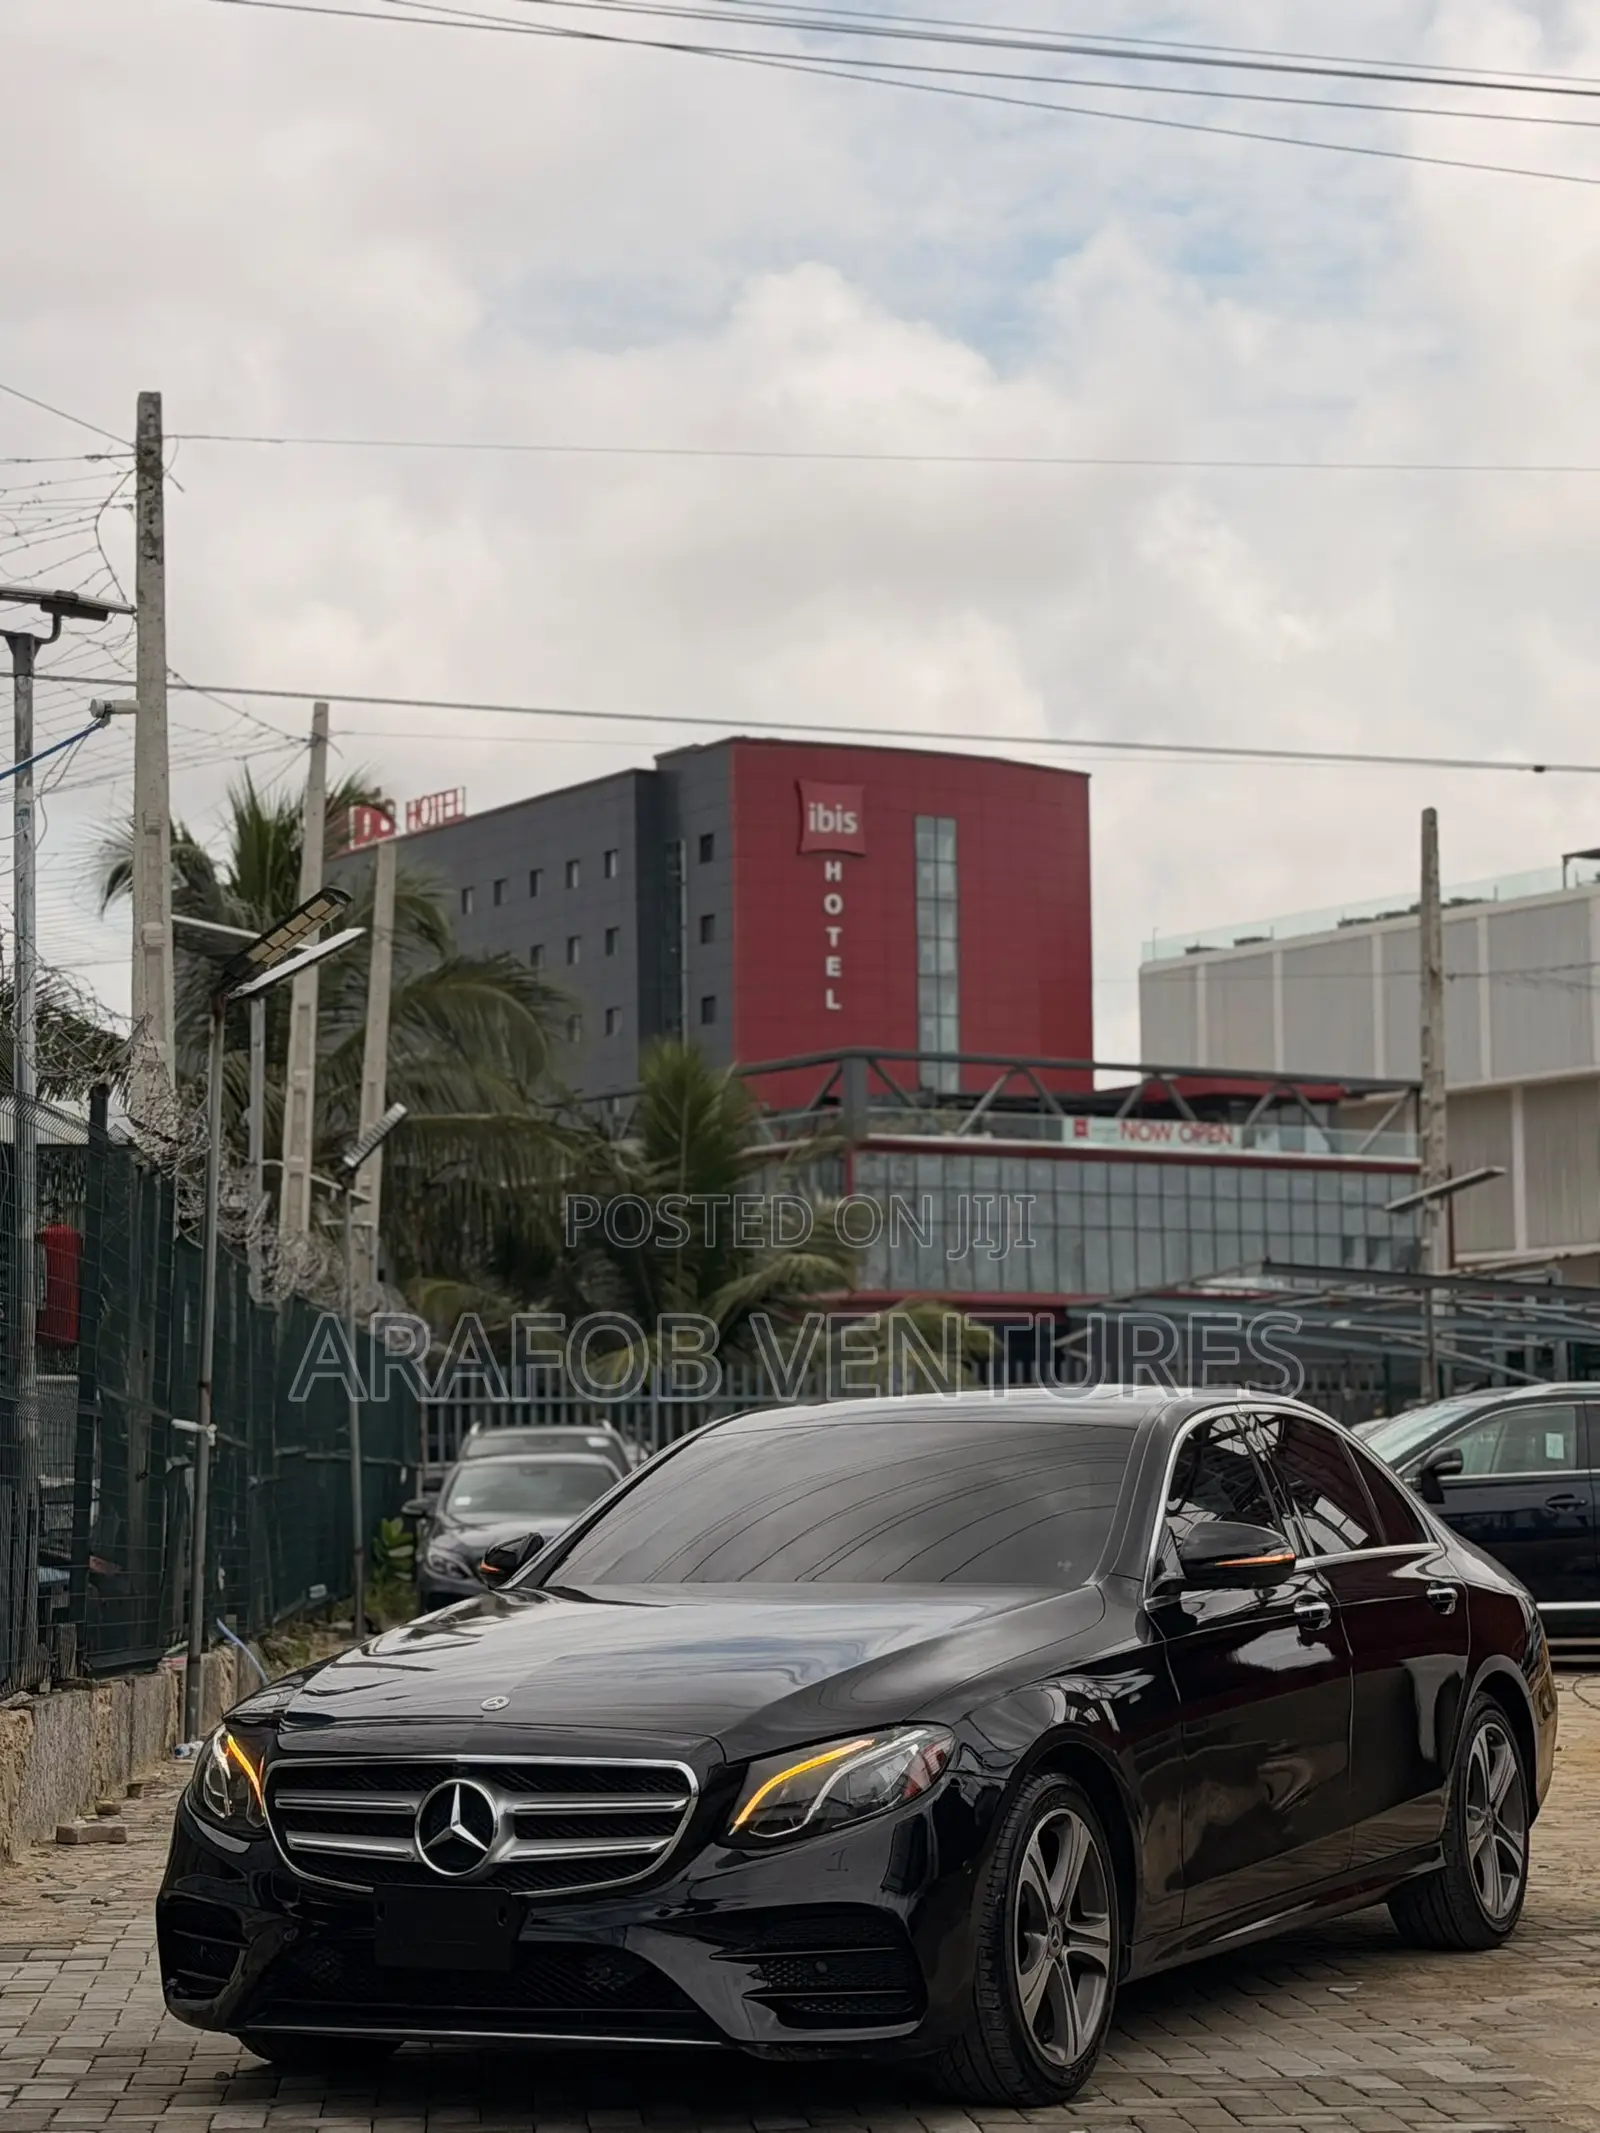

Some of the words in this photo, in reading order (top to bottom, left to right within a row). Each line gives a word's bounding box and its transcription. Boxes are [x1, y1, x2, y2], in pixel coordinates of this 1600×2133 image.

[808, 803, 858, 834] ibis
[824, 860, 843, 1010] HOTEL
[1119, 1120, 1172, 1142] NOW
[1179, 1123, 1235, 1145] OPEN
